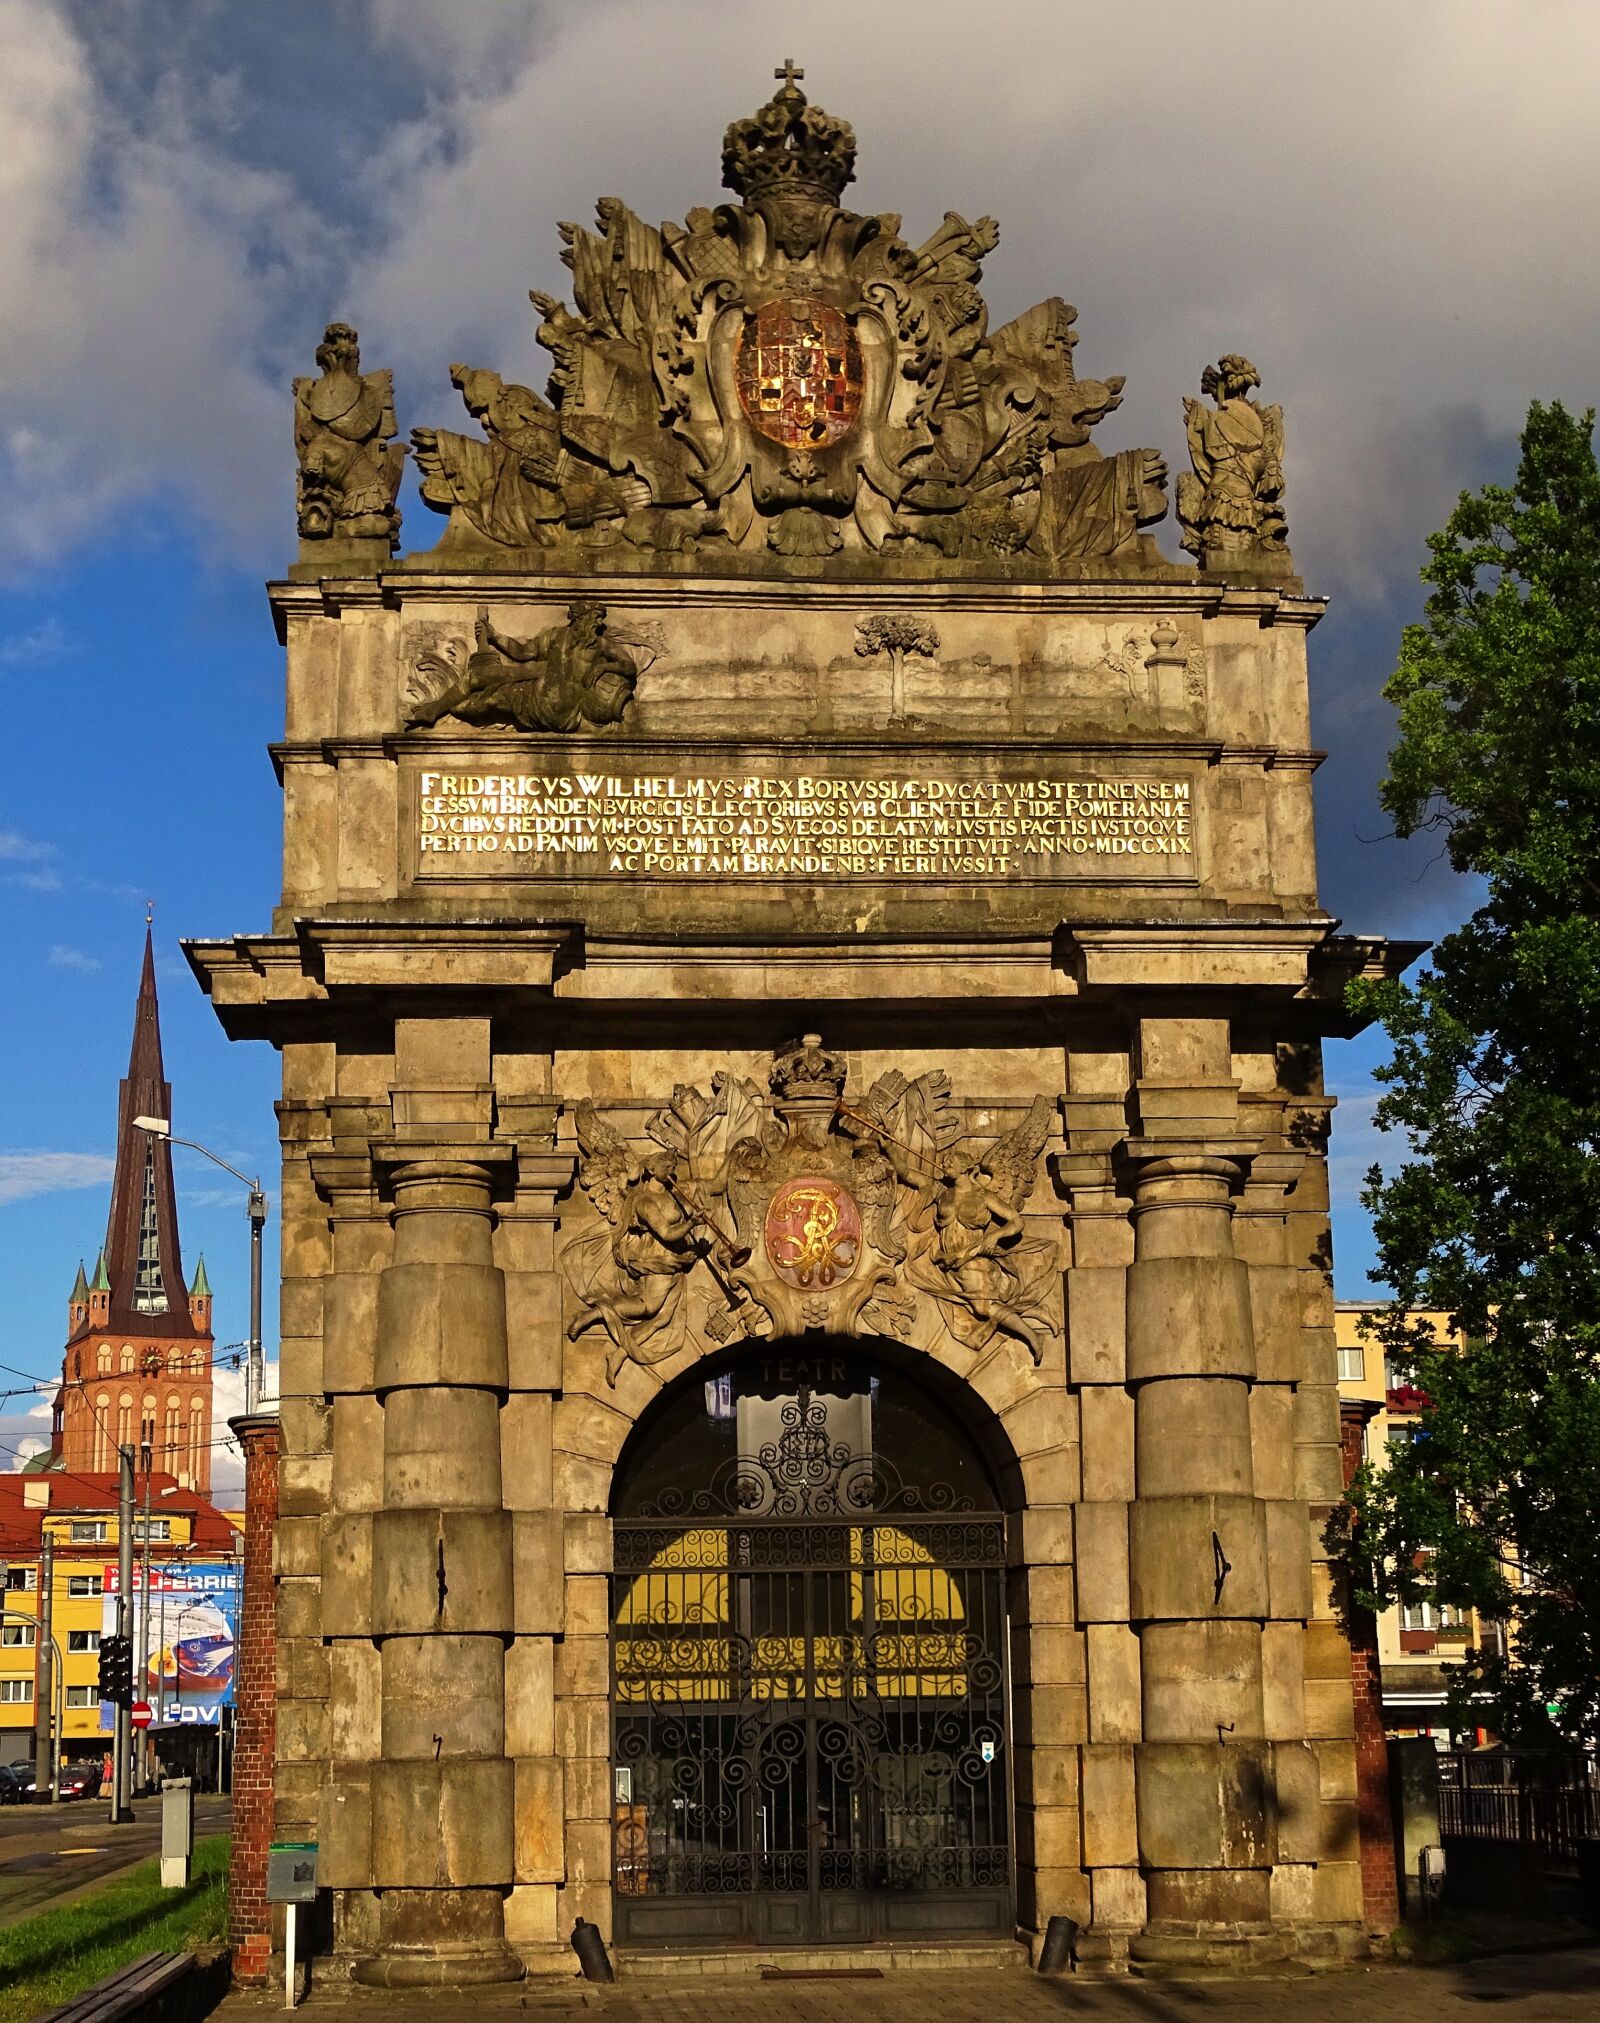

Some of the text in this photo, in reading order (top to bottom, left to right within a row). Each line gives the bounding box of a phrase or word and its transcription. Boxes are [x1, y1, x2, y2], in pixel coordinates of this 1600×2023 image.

[421, 773, 573, 796] FRIDERICVS
[743, 777, 793, 798] REX
[927, 781, 1034, 799] DVCATVM
[1038, 780, 1189, 799] STETINENSEM
[421, 798, 497, 814] CESSVM
[697, 798, 835, 817] ELECTORIBVS
[838, 801, 876, 817] SVB
[1013, 800, 1061, 817] FIDE
[421, 814, 1190, 836] DVCIBVS REDDITVM POST FATO AD SVECOS DELATVM IVSTIS PACTIS IVSTOQVE
[502, 836, 532, 851] AD
[673, 838, 724, 853] EMIT
[731, 837, 815, 854] PARAVIT
[822, 838, 898, 854] SIBIQVE
[902, 838, 1012, 854] RESTITVIT
[1023, 837, 1088, 854] ANNO
[609, 855, 638, 871] AC
[878, 857, 936, 873] FIERI
[942, 857, 1011, 873] IVSSIT
[761, 1358, 846, 1381] TEATR
